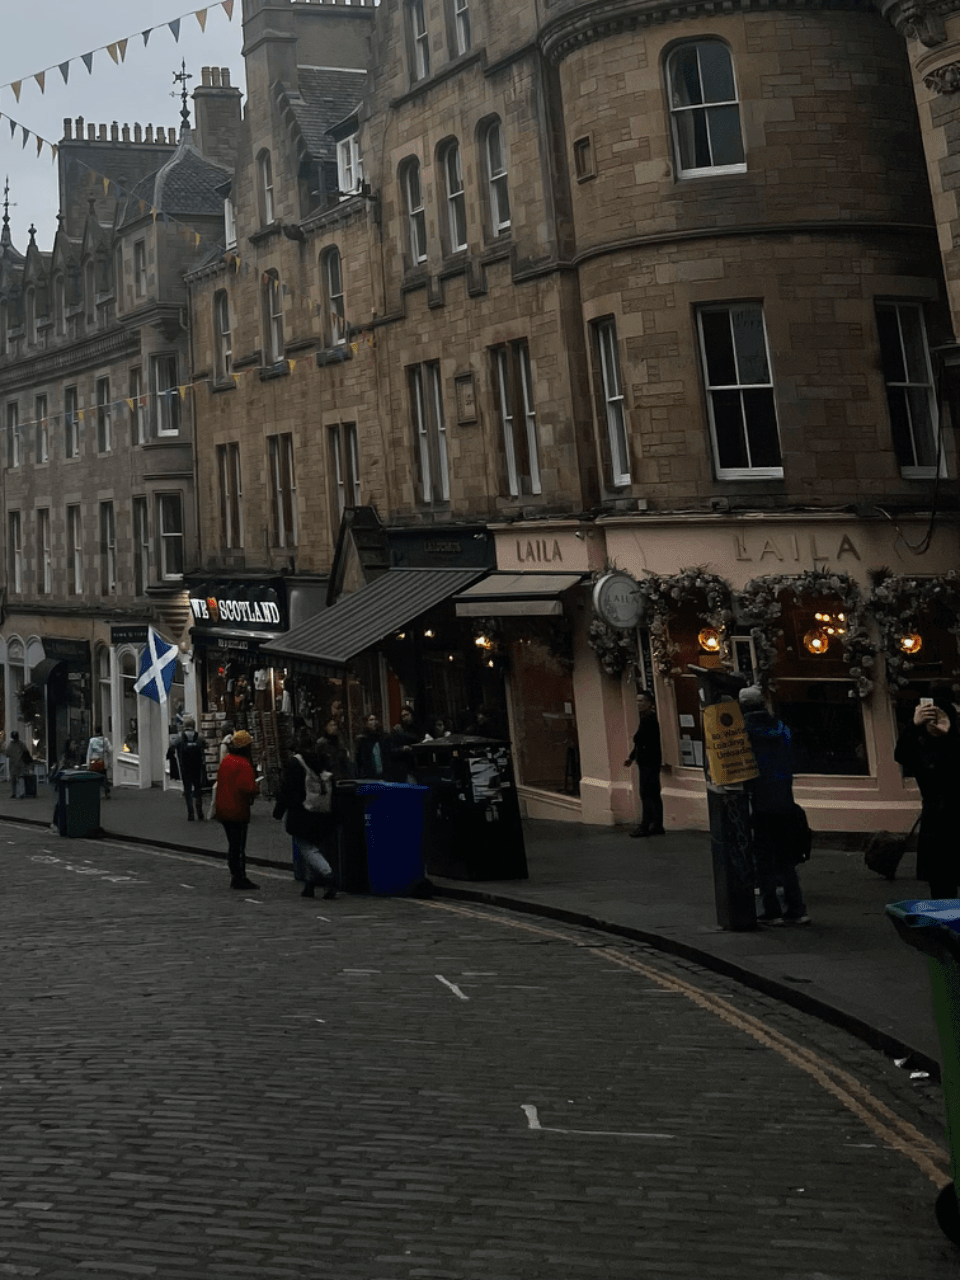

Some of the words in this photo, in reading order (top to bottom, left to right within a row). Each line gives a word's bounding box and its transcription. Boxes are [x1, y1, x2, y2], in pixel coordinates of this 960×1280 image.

[516, 539, 563, 563] LAILA
[734, 534, 861, 562] LAILA
[190, 598, 210, 620] WE
[218, 599, 280, 624] SCOTLAND
[607, 594, 639, 604] LAILA
